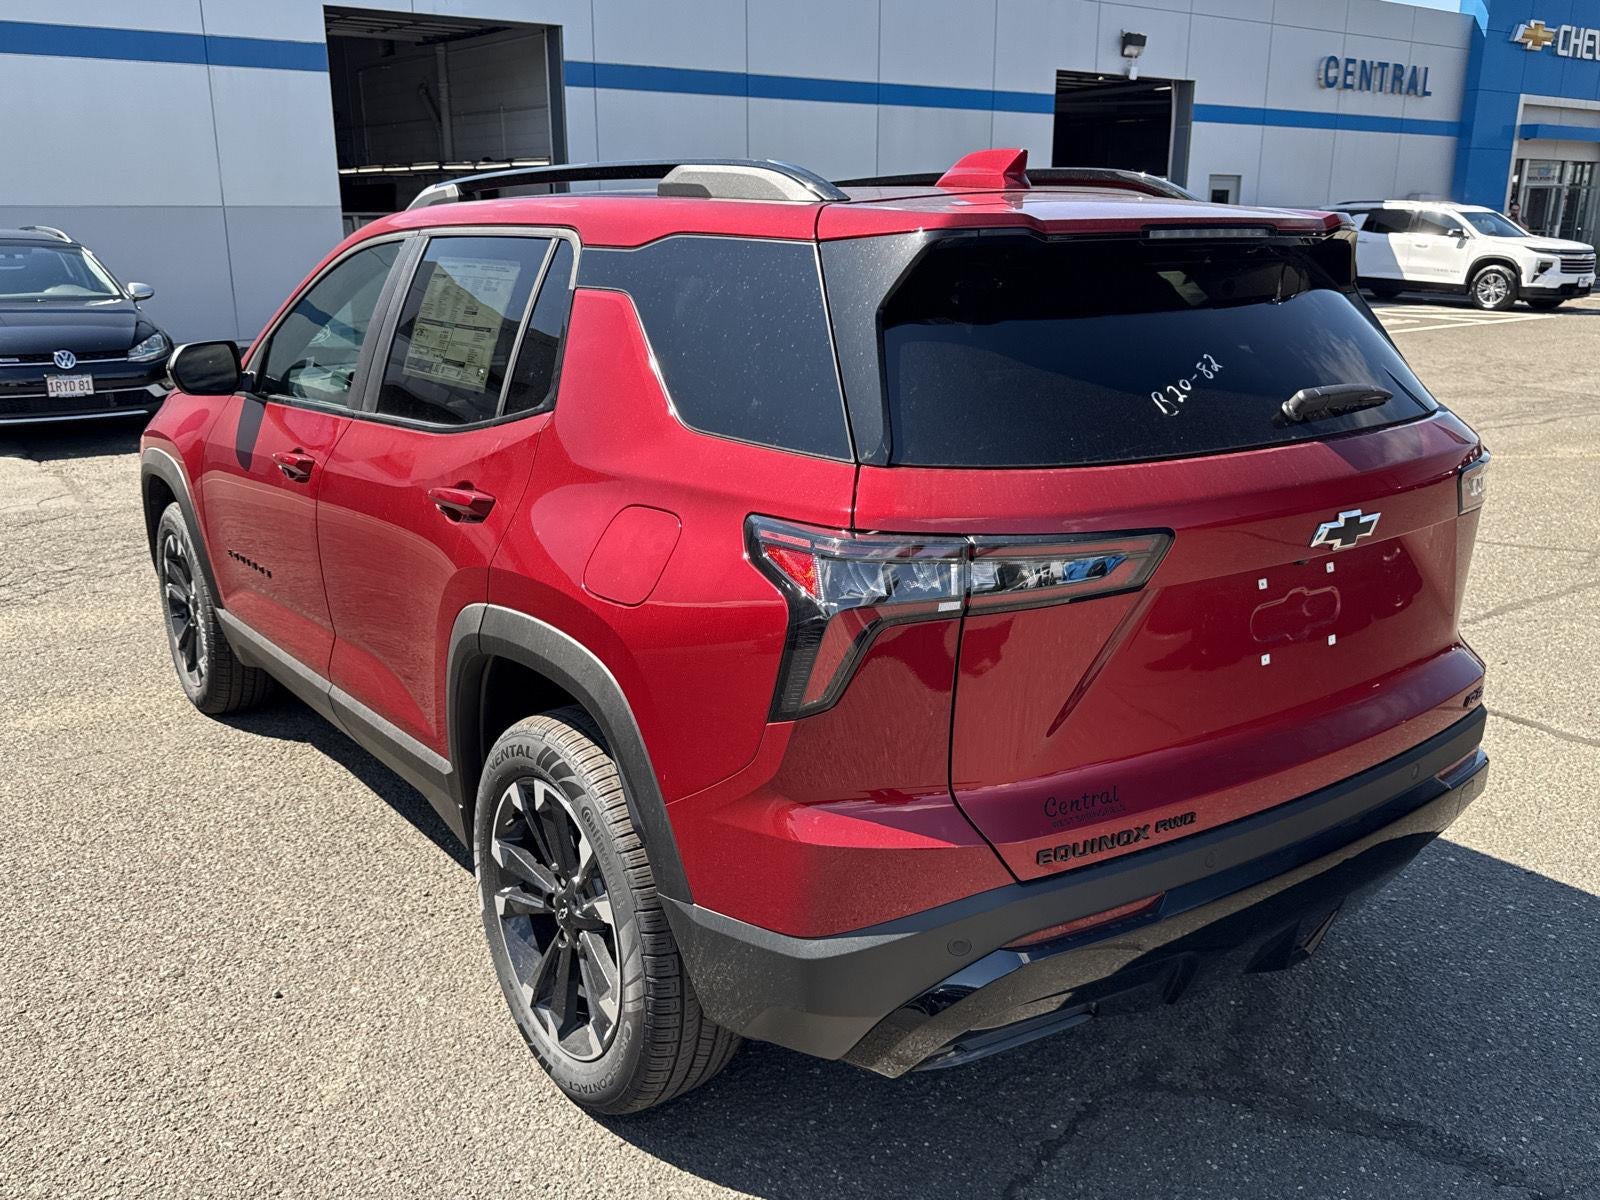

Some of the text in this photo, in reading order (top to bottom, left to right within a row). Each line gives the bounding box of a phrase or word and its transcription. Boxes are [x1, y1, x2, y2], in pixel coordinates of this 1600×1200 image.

[1322, 55, 1432, 97] CENTRAL
[78, 380, 92, 391] 81
[1044, 785, 1119, 817] Central
[1036, 824, 1151, 866] EQUINOX
